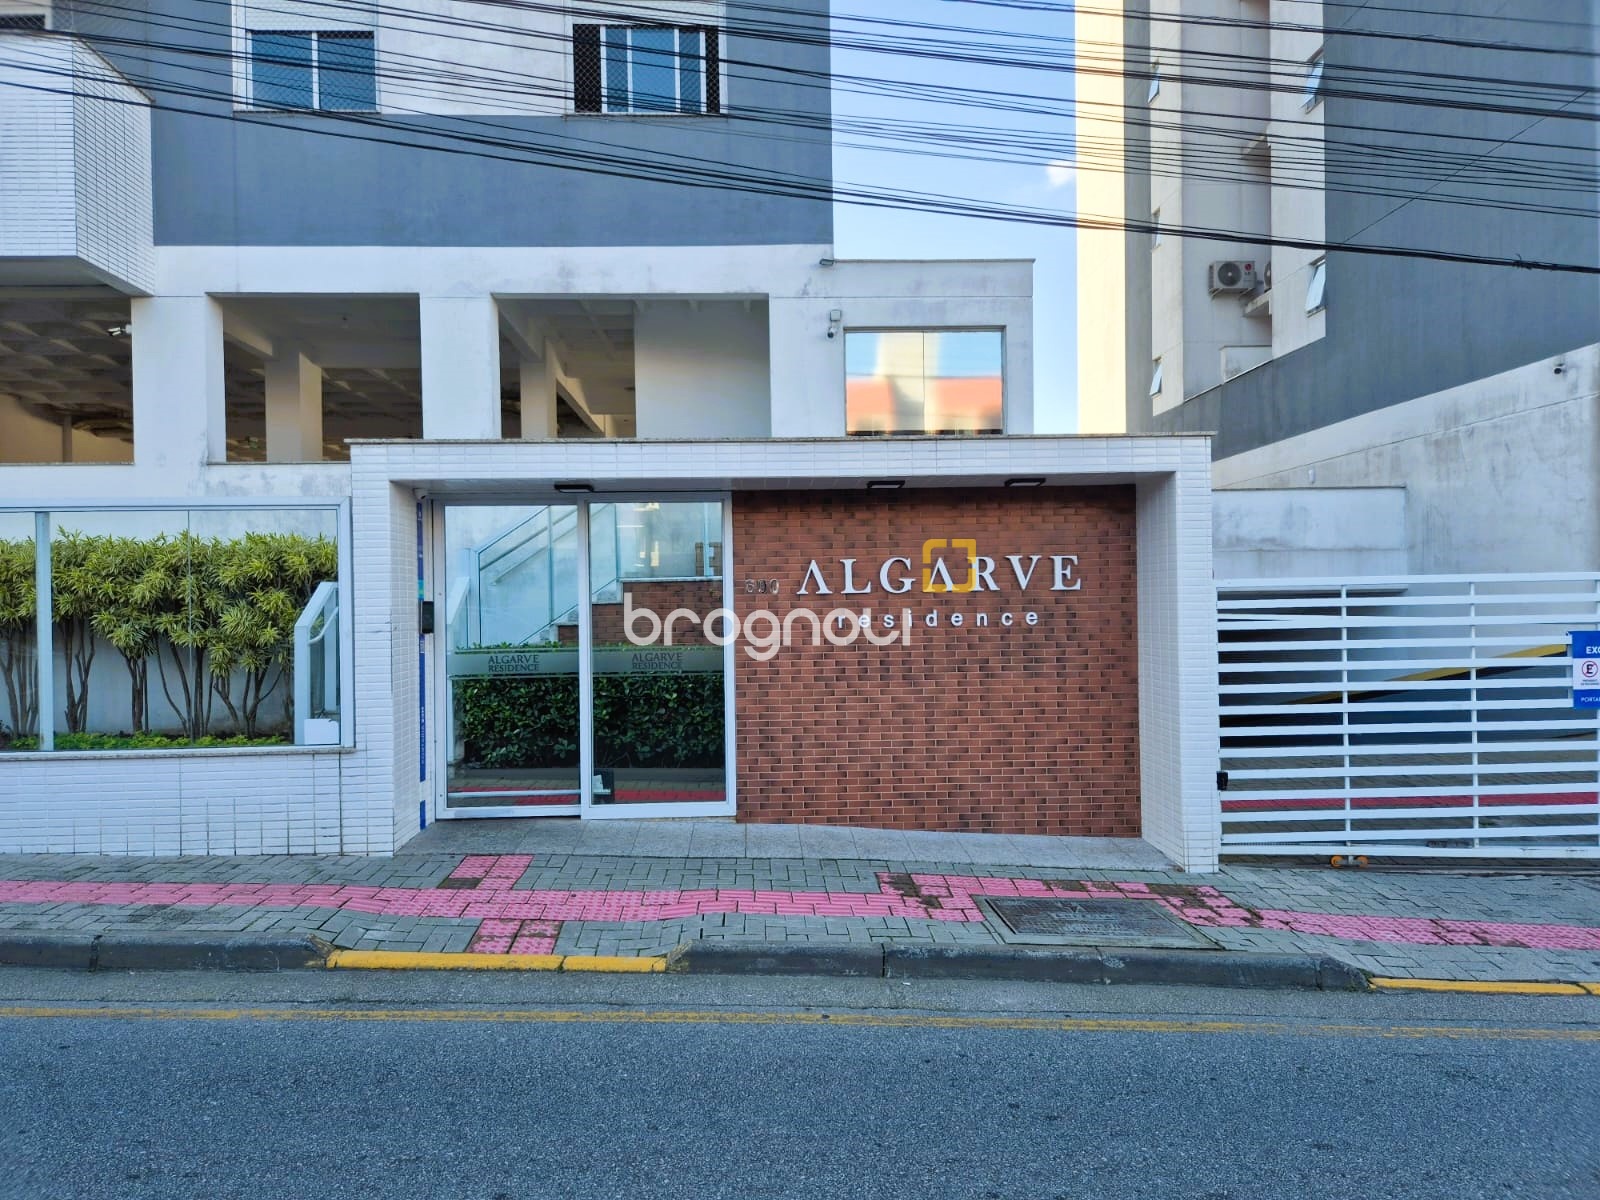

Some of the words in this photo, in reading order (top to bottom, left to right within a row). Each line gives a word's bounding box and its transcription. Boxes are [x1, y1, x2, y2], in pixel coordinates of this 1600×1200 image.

[796, 555, 1082, 594] ALGARVE
[836, 607, 1039, 629] residence
[487, 654, 541, 665] ALGARVE
[631, 652, 684, 662] ALGARVE
[488, 664, 541, 673] RESIDENCE
[631, 661, 683, 670] RESIDENCE
